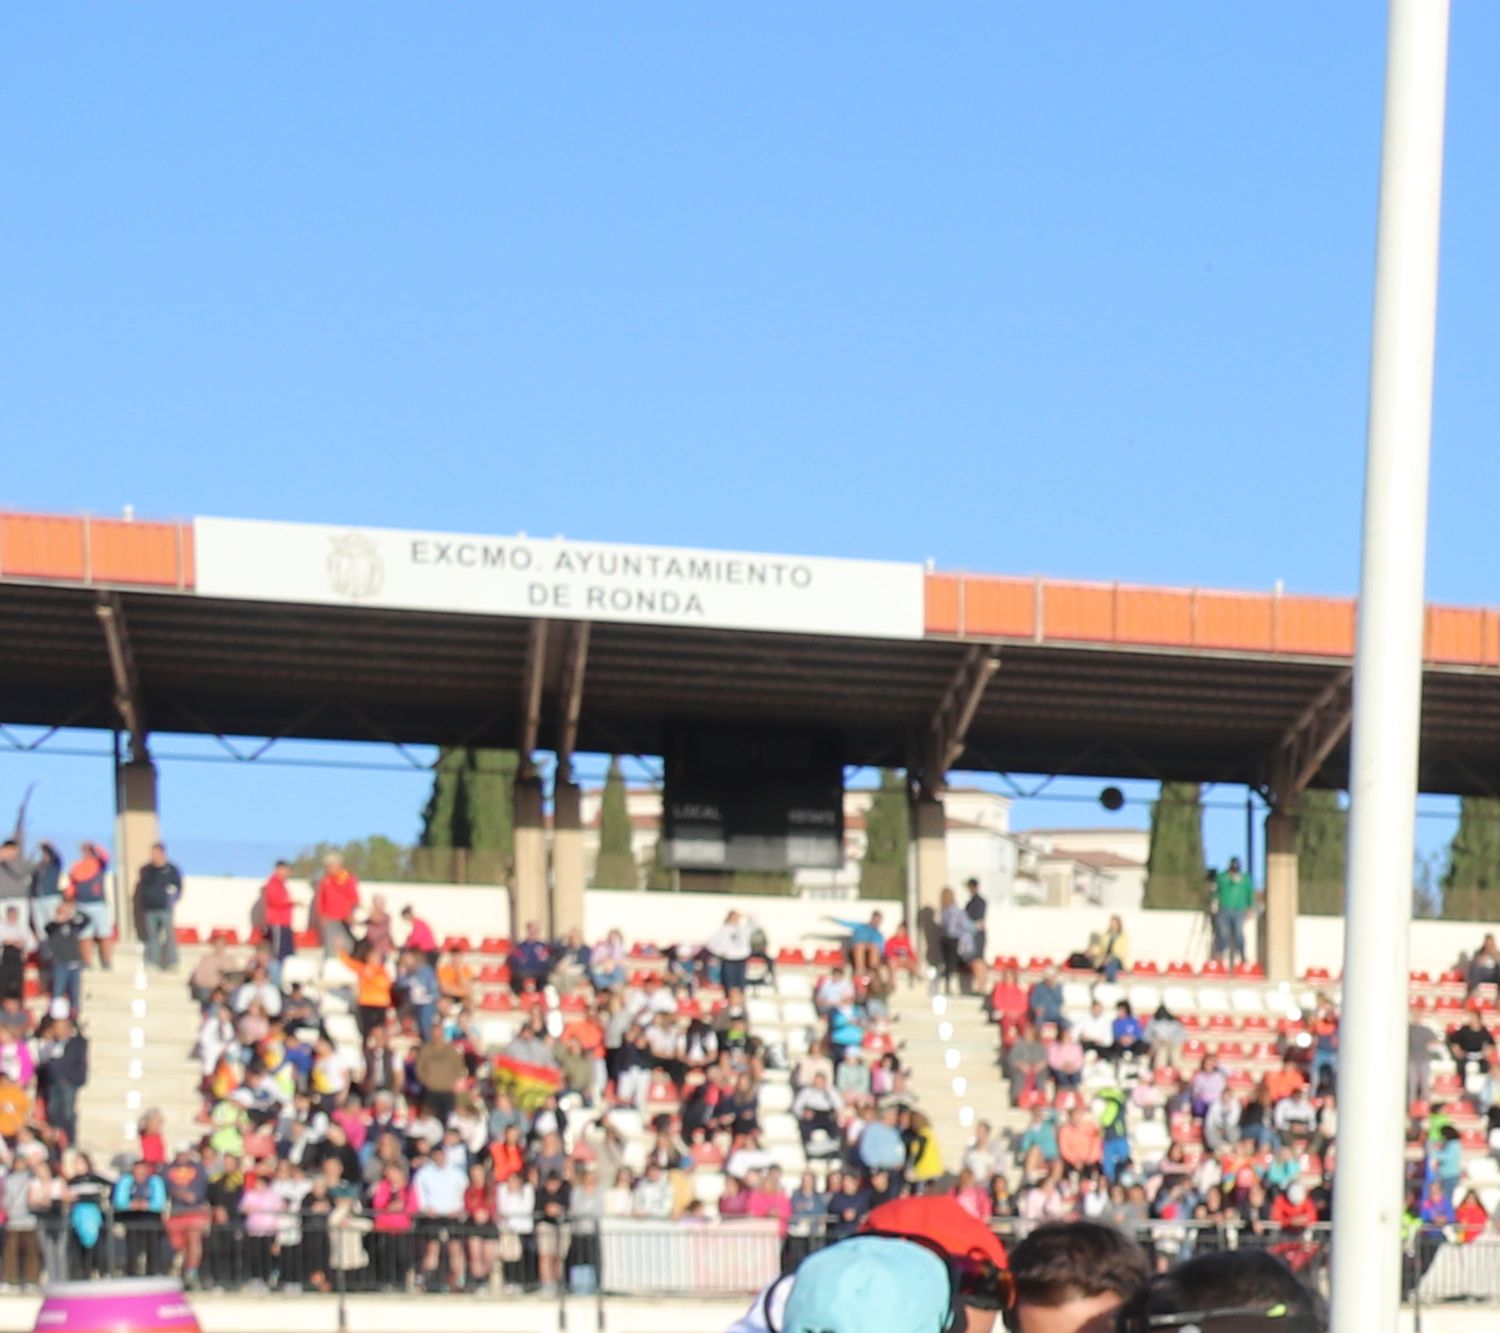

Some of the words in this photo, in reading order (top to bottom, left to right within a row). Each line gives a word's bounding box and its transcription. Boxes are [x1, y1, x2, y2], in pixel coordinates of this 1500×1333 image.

[411, 541, 542, 573] EXCMO.
[555, 550, 812, 589] AYUNTAMIENTO
[528, 583, 570, 607] DE
[587, 588, 705, 616] RONDA
